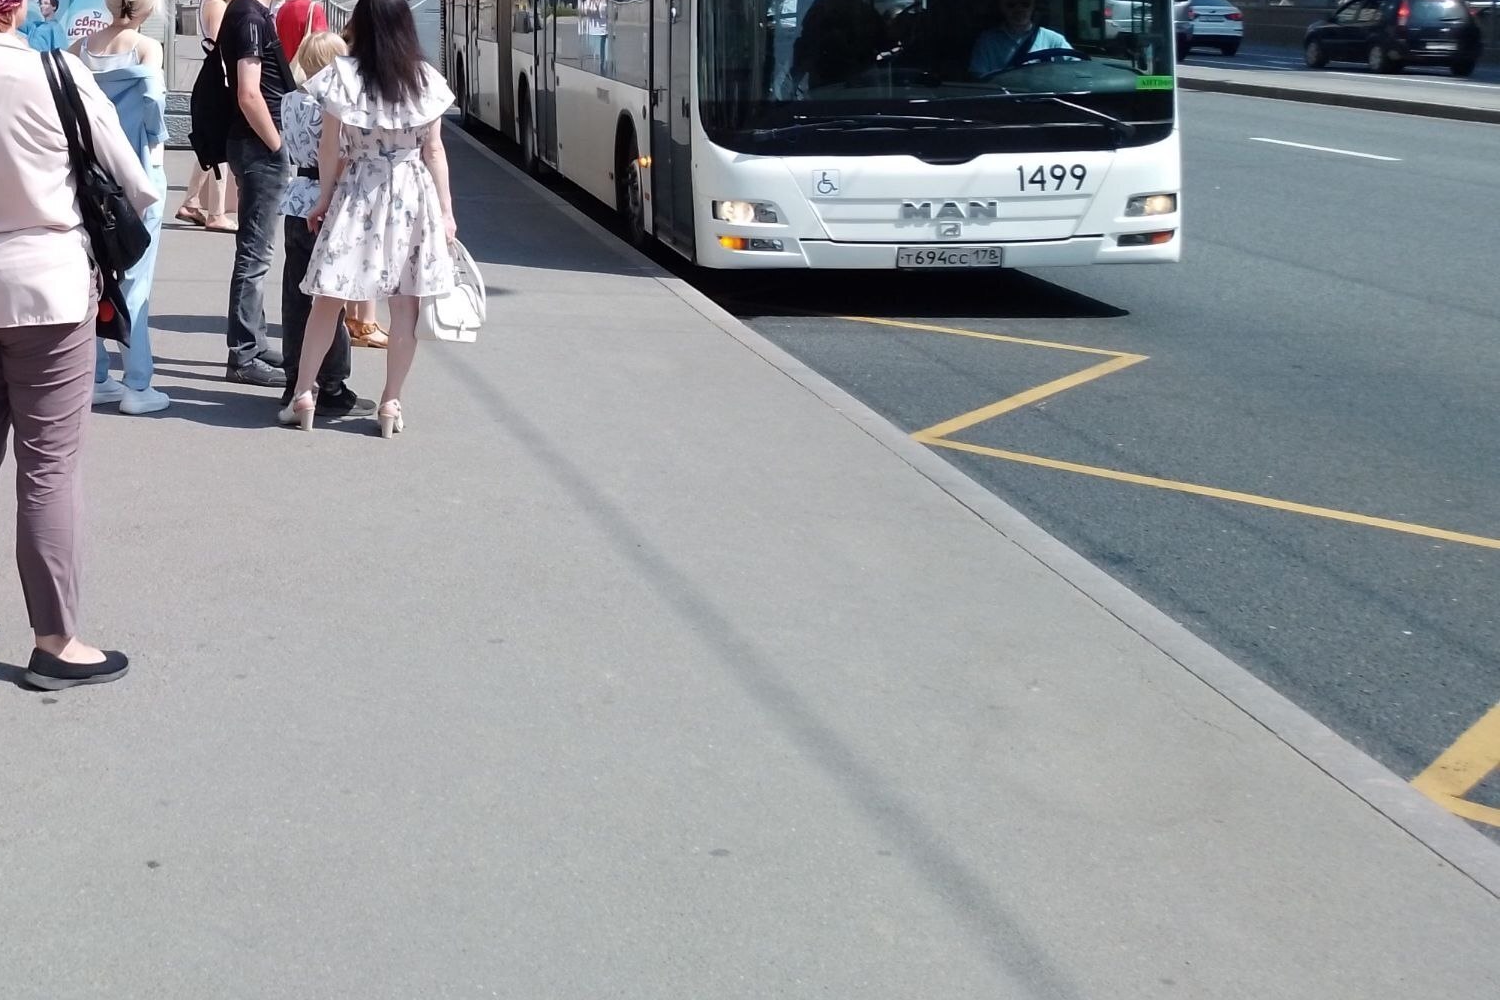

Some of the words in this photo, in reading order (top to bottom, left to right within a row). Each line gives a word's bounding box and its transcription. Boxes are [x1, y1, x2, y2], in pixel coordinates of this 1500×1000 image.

[1016, 164, 1087, 192] 1499
[902, 200, 998, 220] MAN
[972, 248, 995, 260] 178
